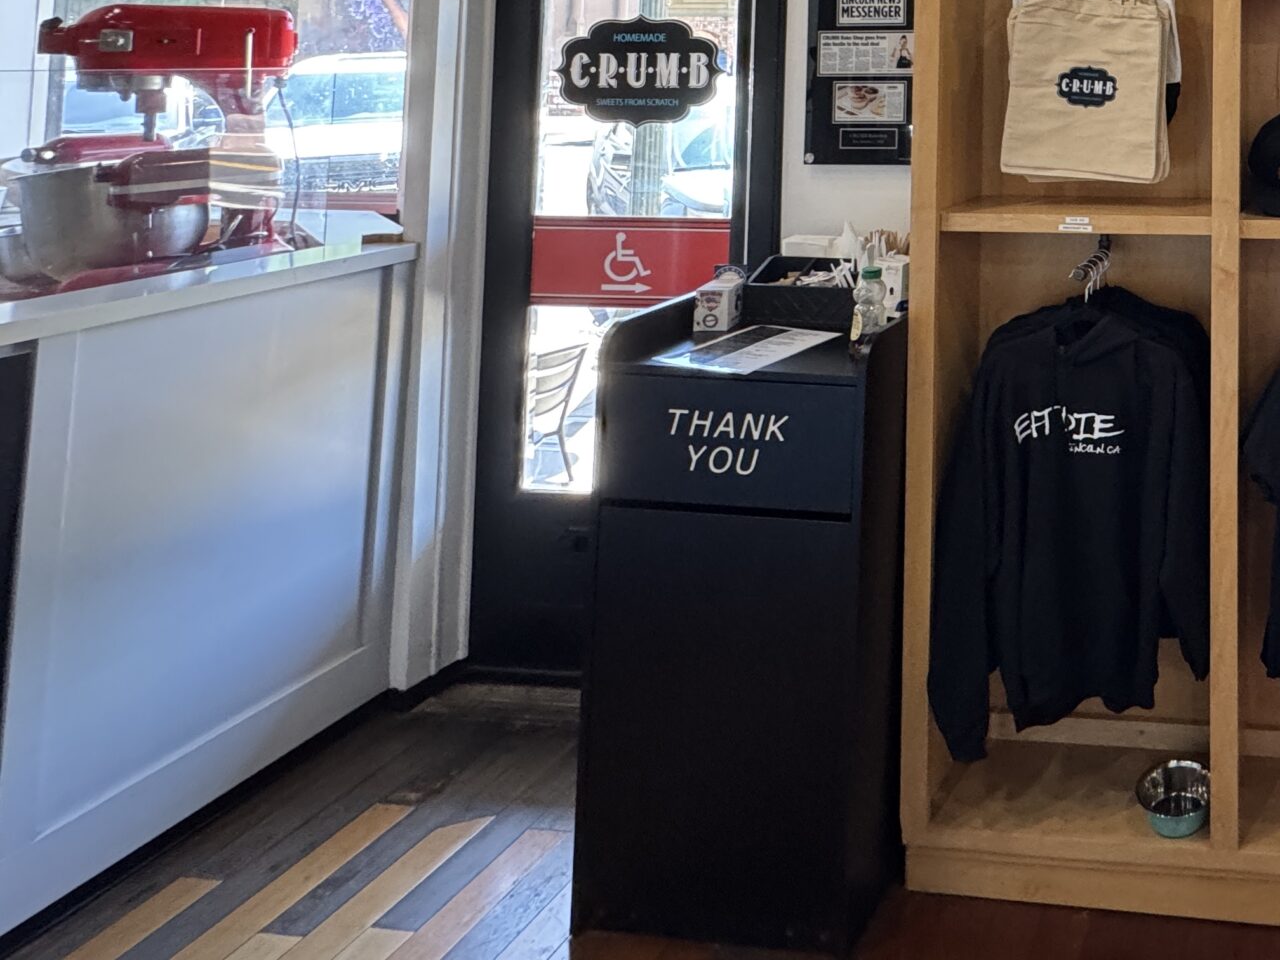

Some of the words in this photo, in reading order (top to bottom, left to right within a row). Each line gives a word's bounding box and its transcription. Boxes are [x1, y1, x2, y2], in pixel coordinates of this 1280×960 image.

[841, 5, 901, 18] MESSENGER
[613, 33, 667, 42] HOMEMADE
[596, 98, 623, 106] SWEETS
[624, 98, 646, 106] FROM
[647, 98, 679, 107] SCRATCH
[668, 408, 789, 441] THANK
[1014, 407, 1060, 444] EAT
[688, 444, 759, 475] YOU
